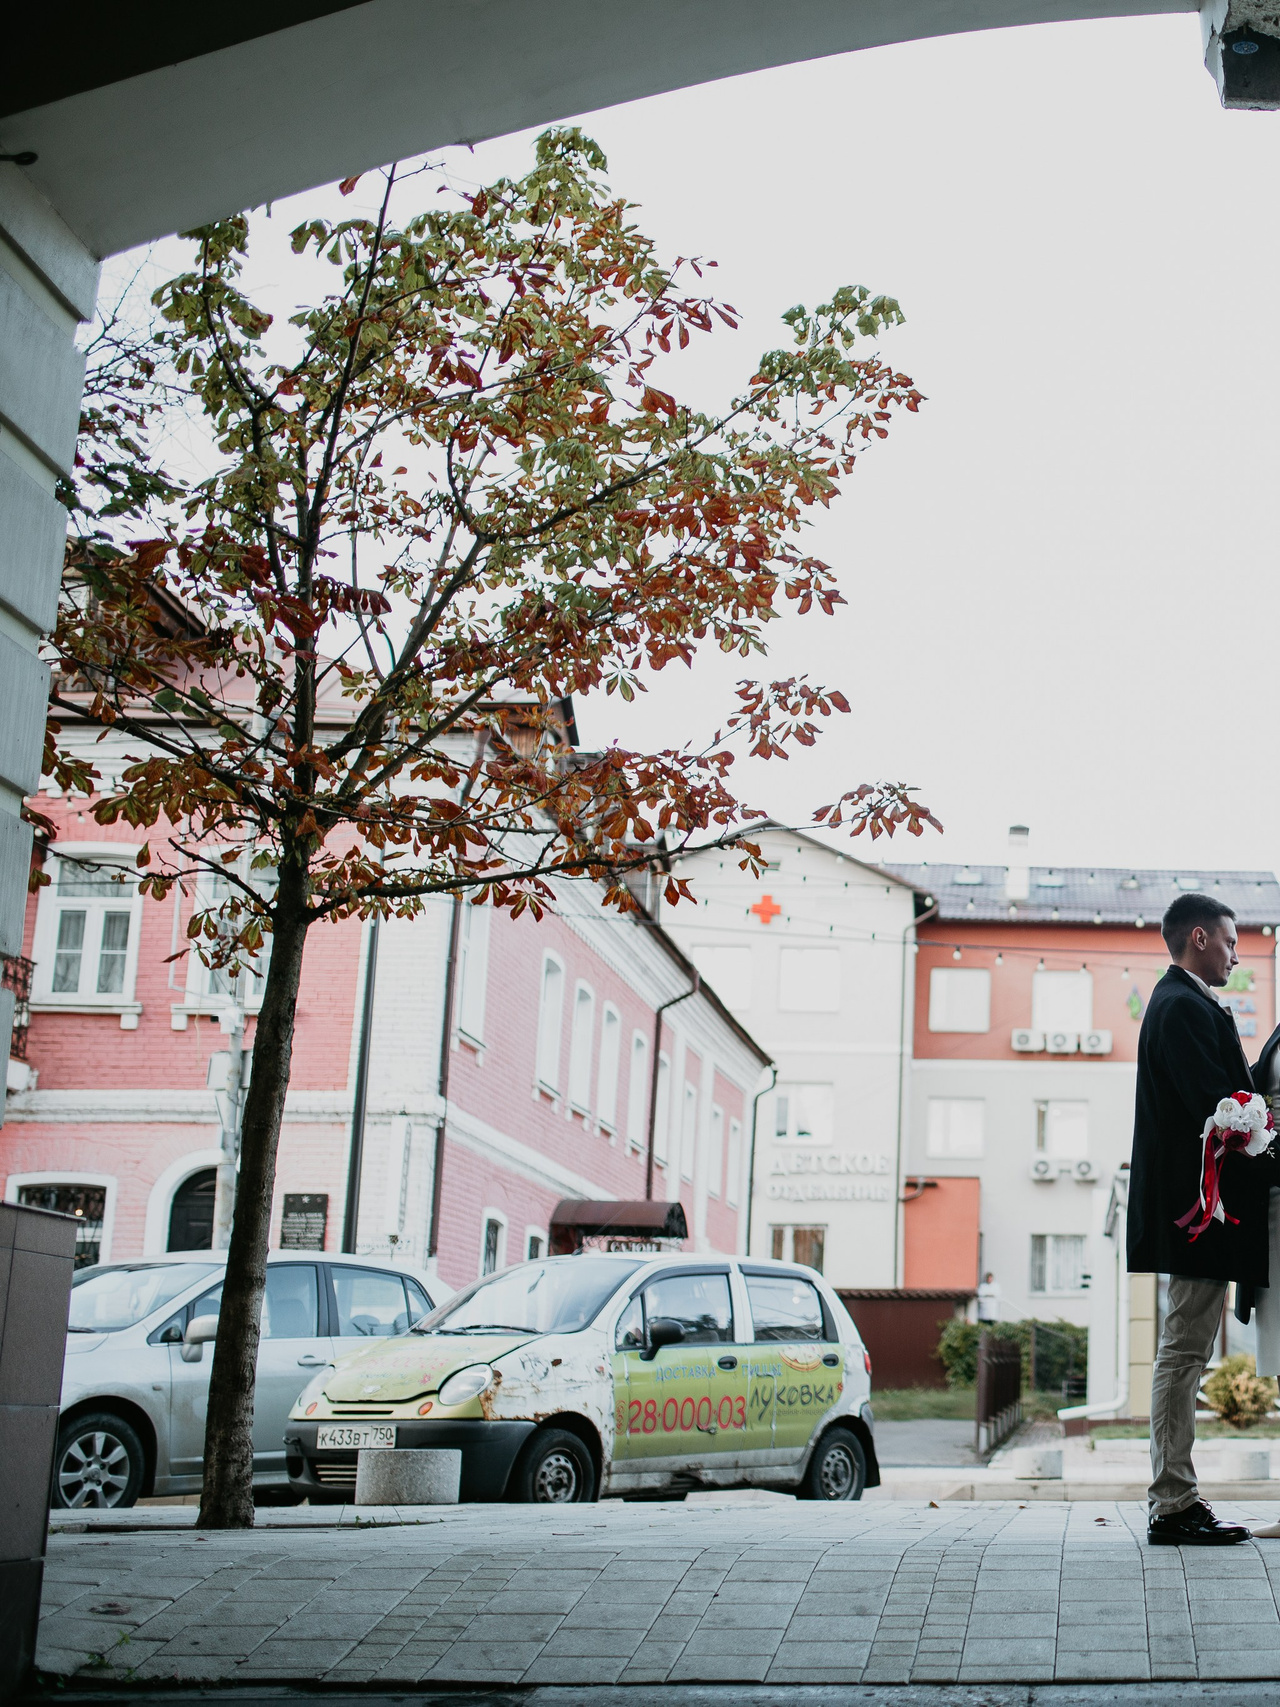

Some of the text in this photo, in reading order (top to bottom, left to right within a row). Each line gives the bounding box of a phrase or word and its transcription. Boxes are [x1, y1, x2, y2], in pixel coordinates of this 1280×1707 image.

[769, 1152, 890, 1176] ДЕТСКОЕ
[655, 1364, 718, 1382] ДОСТАВКА
[750, 1384, 835, 1421] ЛУКОВКА
[320, 1427, 393, 1446] К433ВТ 750
